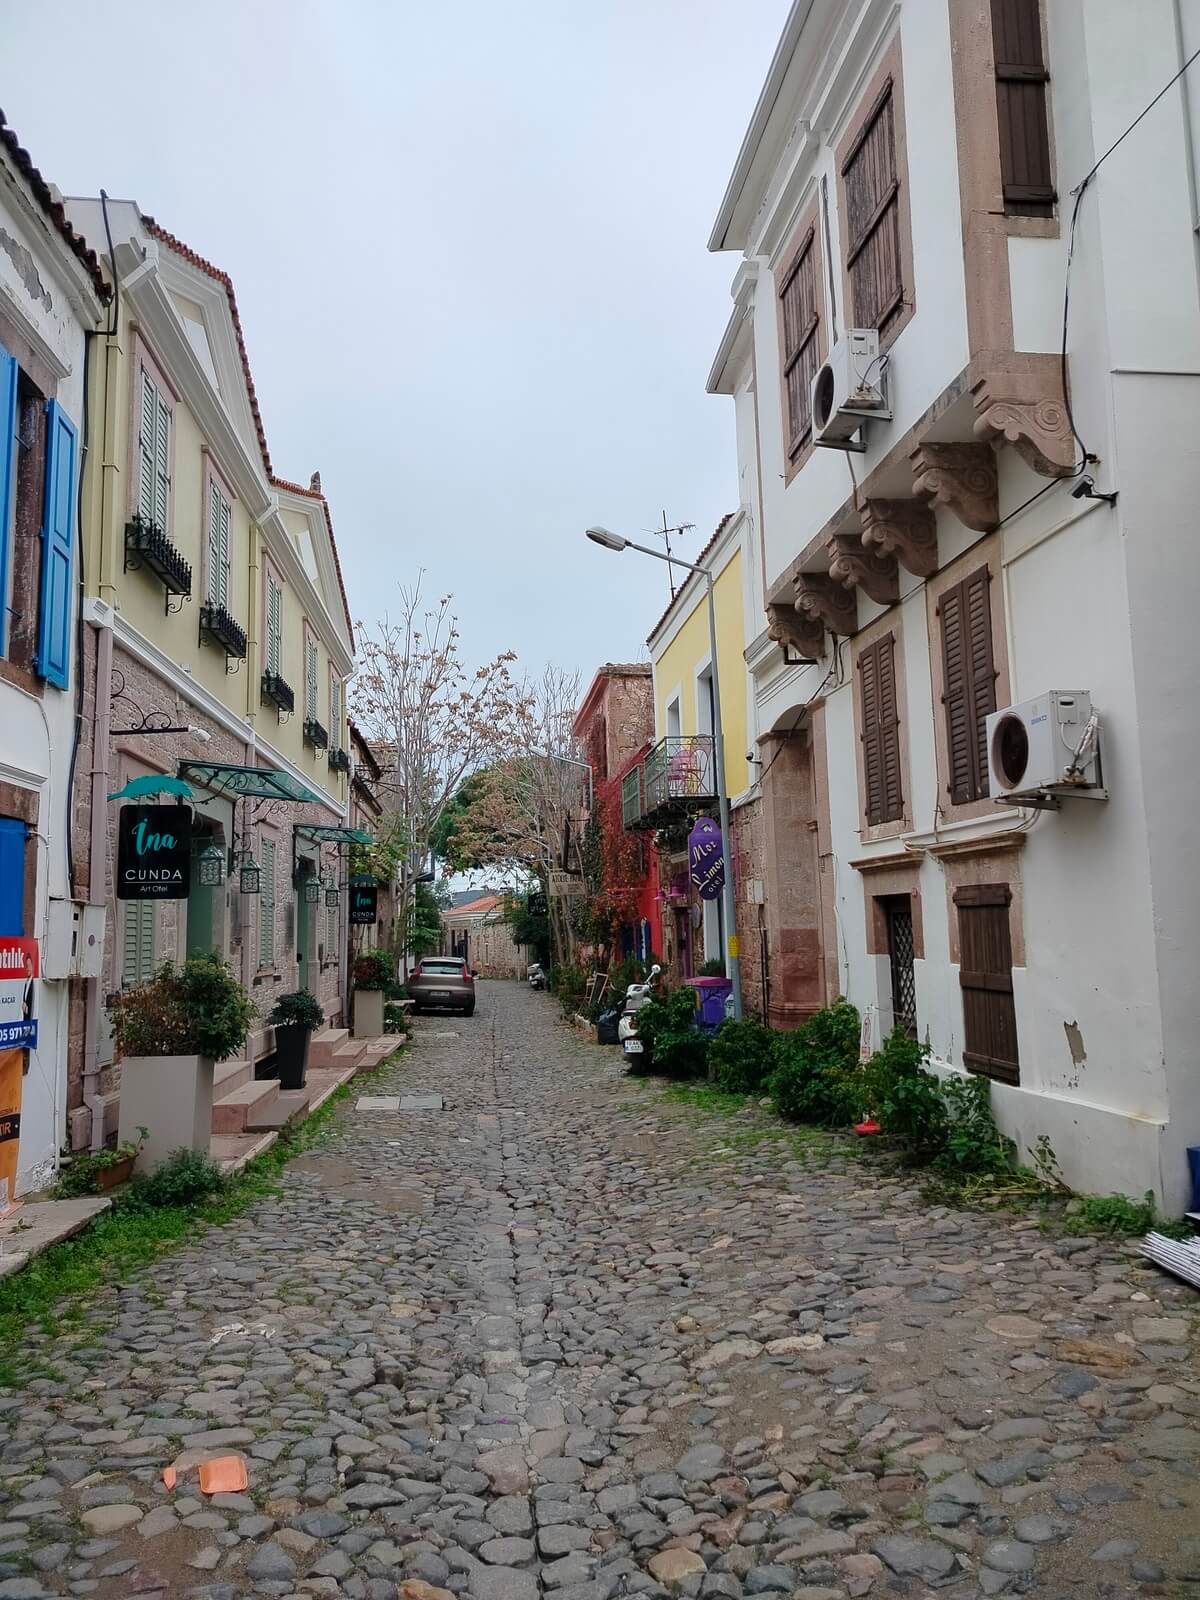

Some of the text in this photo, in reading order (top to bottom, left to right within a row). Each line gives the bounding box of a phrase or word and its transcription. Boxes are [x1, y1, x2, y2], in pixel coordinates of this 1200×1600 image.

[692, 841, 717, 868] Mor
[125, 869, 182, 881] CUNDA
[691, 856, 725, 891] Limon
[140, 885, 168, 893] Art Otel
